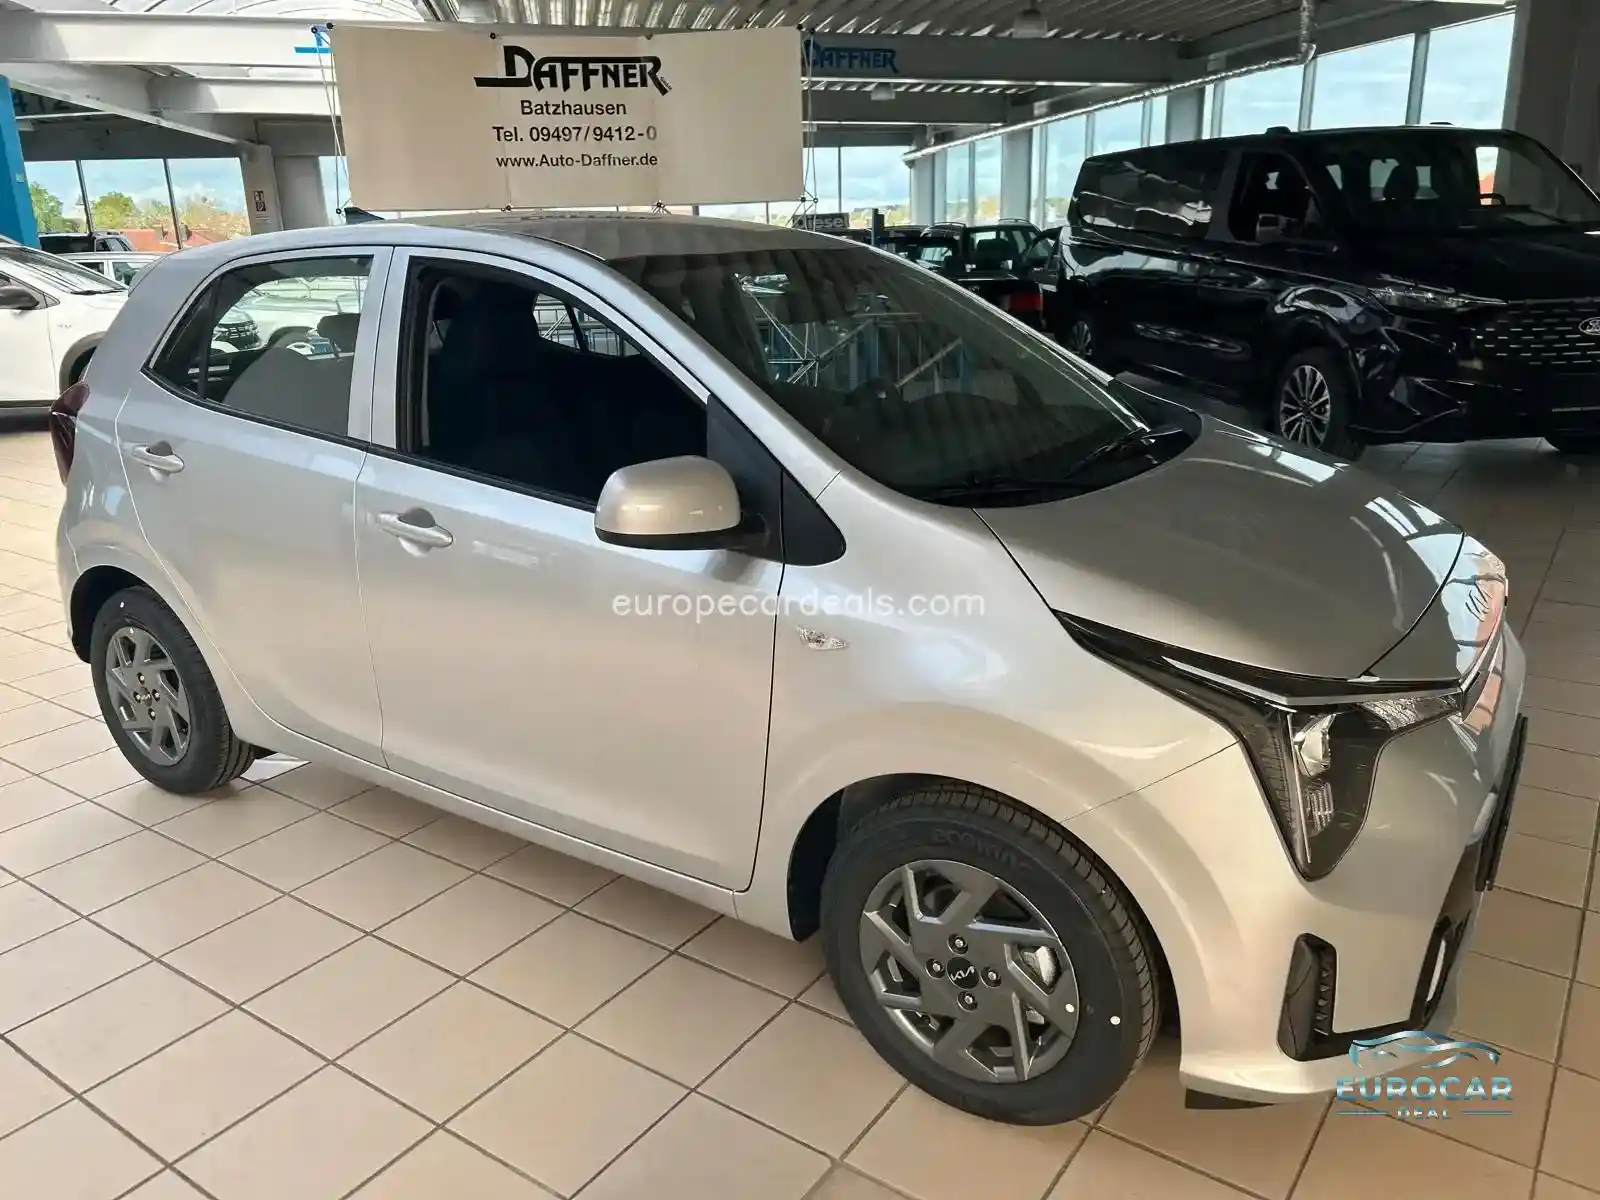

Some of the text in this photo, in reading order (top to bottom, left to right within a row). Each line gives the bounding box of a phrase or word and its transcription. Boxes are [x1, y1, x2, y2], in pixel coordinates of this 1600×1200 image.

[474, 45, 668, 96] DAFFNER
[520, 100, 627, 116] Batzhausen
[492, 126, 524, 142] Tel.
[495, 153, 658, 168] www.Auto-Daffner.de
